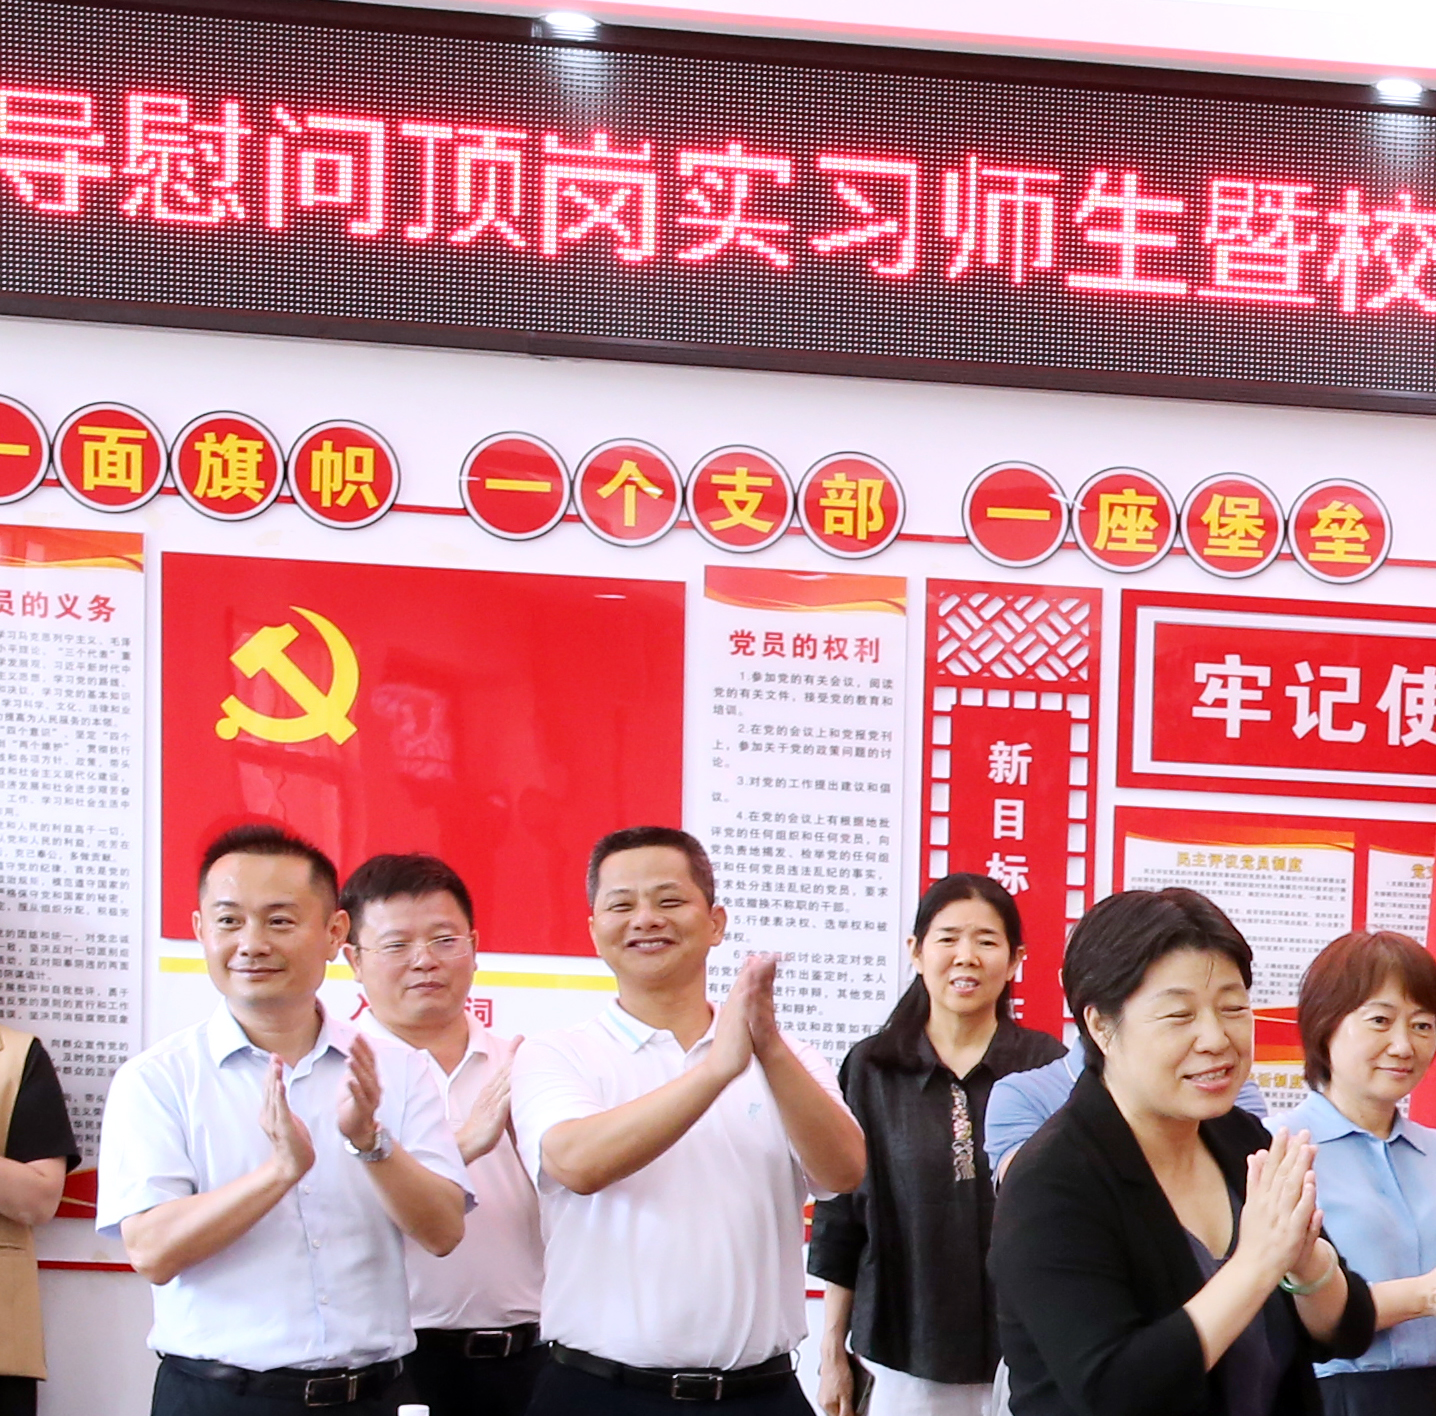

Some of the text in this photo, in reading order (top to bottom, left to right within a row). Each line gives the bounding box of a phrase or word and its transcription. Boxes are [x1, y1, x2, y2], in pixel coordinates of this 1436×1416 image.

[484, 459, 886, 541] 一个支部
[986, 488, 1374, 565] 一座堡垒
[729, 629, 880, 663] 党员的权利
[986, 740, 1032, 896] 新目标
